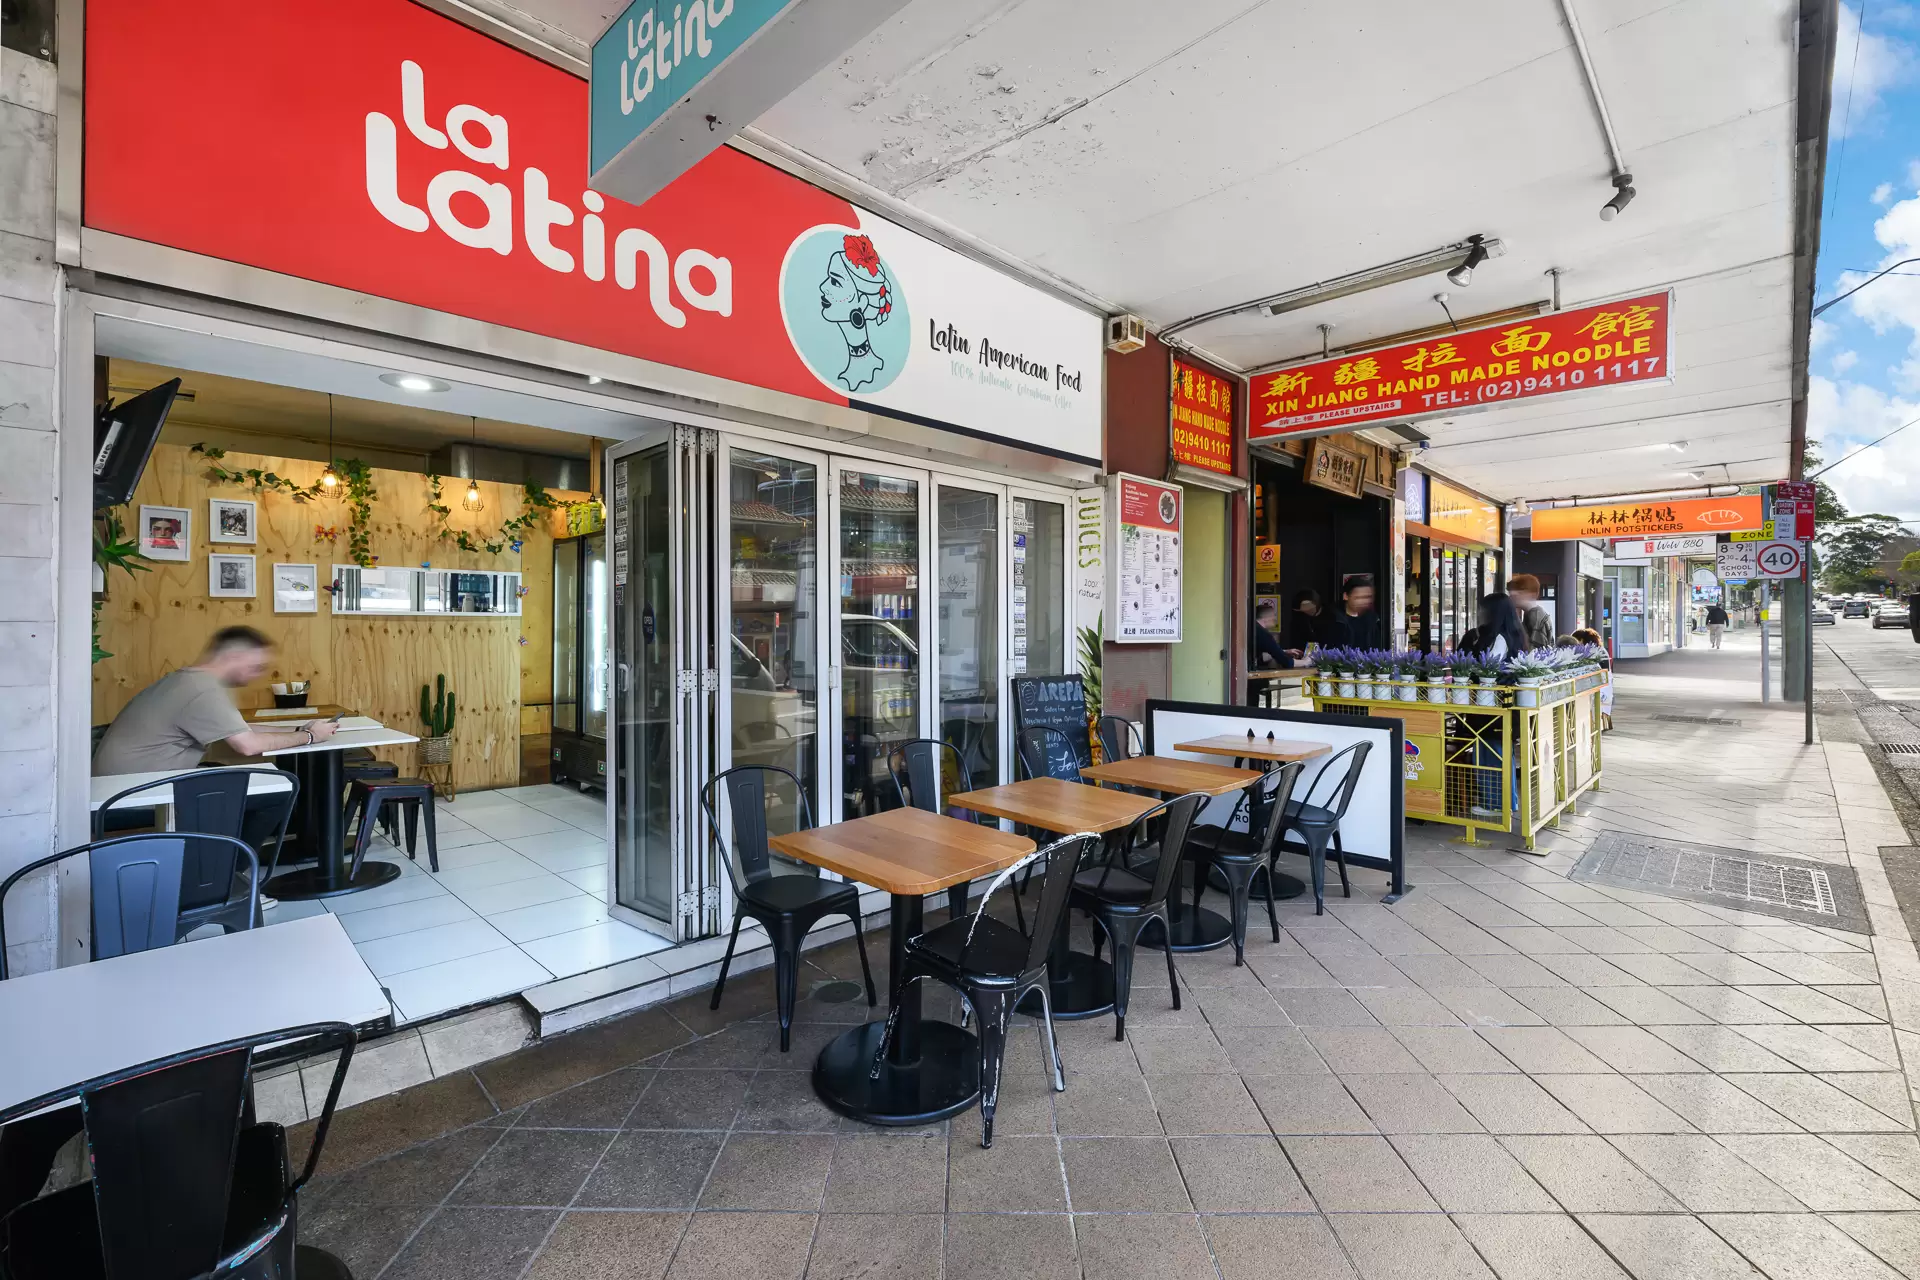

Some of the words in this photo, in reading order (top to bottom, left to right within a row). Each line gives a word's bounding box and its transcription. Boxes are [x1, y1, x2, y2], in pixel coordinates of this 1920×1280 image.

[628, 8, 653, 60] La
[401, 60, 509, 170] La
[365, 111, 733, 329] Latina
[930, 318, 971, 354] Latin
[979, 337, 1049, 381] American
[1056, 364, 1082, 393] Food
[1265, 398, 1298, 416] XIN
[1306, 387, 1368, 409] JIANG
[1378, 374, 1440, 397] HAND
[1451, 359, 1521, 385] MADE
[1532, 336, 1650, 371] NOODLE
[1422, 390, 1470, 407] TEL:
[1477, 369, 1585, 402] (02)9410
[1594, 356, 1660, 381] 1117
[1319, 408, 1350, 420] PLEASE
[1353, 401, 1396, 414] UPSTAIRS
[1211, 439, 1231, 457] 1117
[1193, 455, 1210, 466] PLEASE
[1078, 496, 1101, 569] JUICES
[1581, 527, 1611, 535] LINLIN
[1616, 523, 1683, 533] POTSTICKERS
[1741, 531, 1772, 539] ZONE
[1763, 552, 1793, 566] 40
[1079, 590, 1101, 600] natural
[1038, 680, 1084, 702] AREPA
